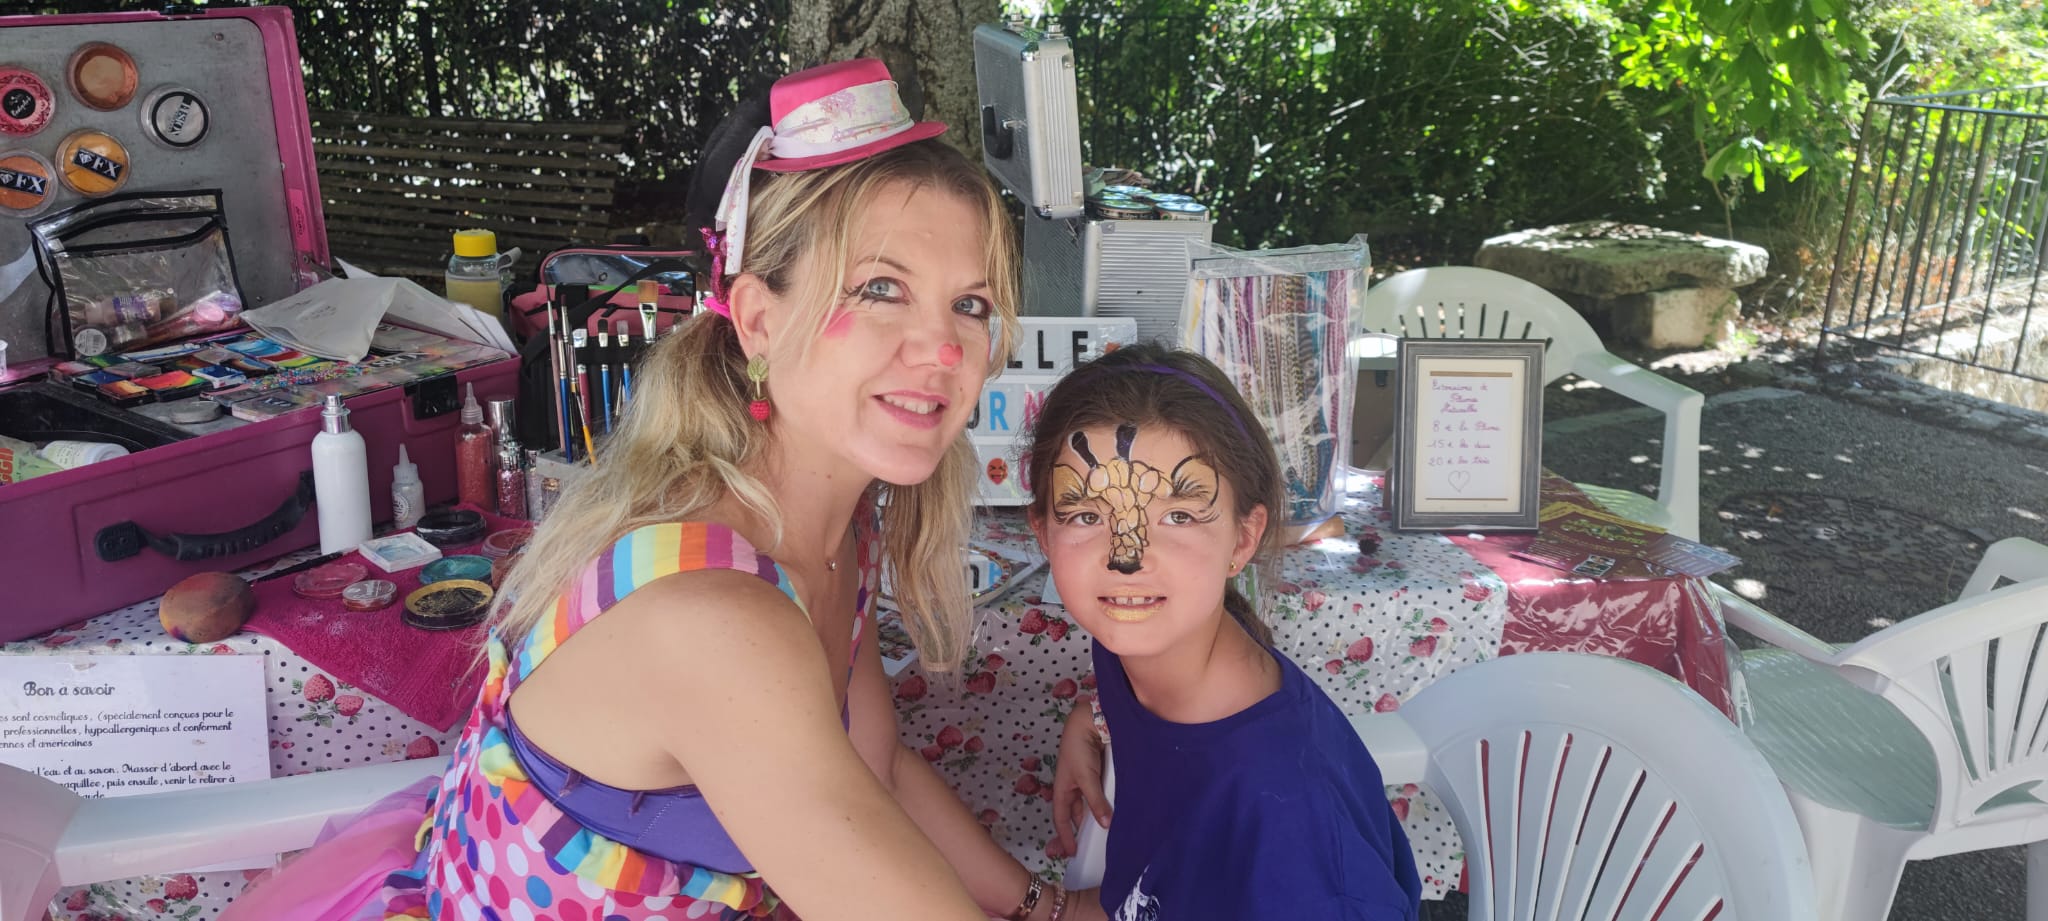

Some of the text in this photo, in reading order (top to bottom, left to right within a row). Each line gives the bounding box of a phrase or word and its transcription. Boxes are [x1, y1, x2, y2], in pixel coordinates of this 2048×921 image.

[23, 681, 56, 696] Bon
[72, 683, 115, 696] savoir
[12, 711, 31, 722] sont
[202, 711, 224, 721] pour
[225, 707, 234, 718] le
[84, 723, 170, 738] hypoallergeniques
[172, 721, 181, 732] et
[182, 720, 232, 732] conforment
[27, 738, 36, 749] et
[38, 739, 93, 749] americaines
[63, 765, 73, 775] et
[121, 762, 160, 773] Masser
[222, 760, 232, 771] le
[106, 778, 126, 790] puis
[164, 776, 188, 785] venir
[188, 774, 198, 785] le
[199, 773, 227, 784] retirer
